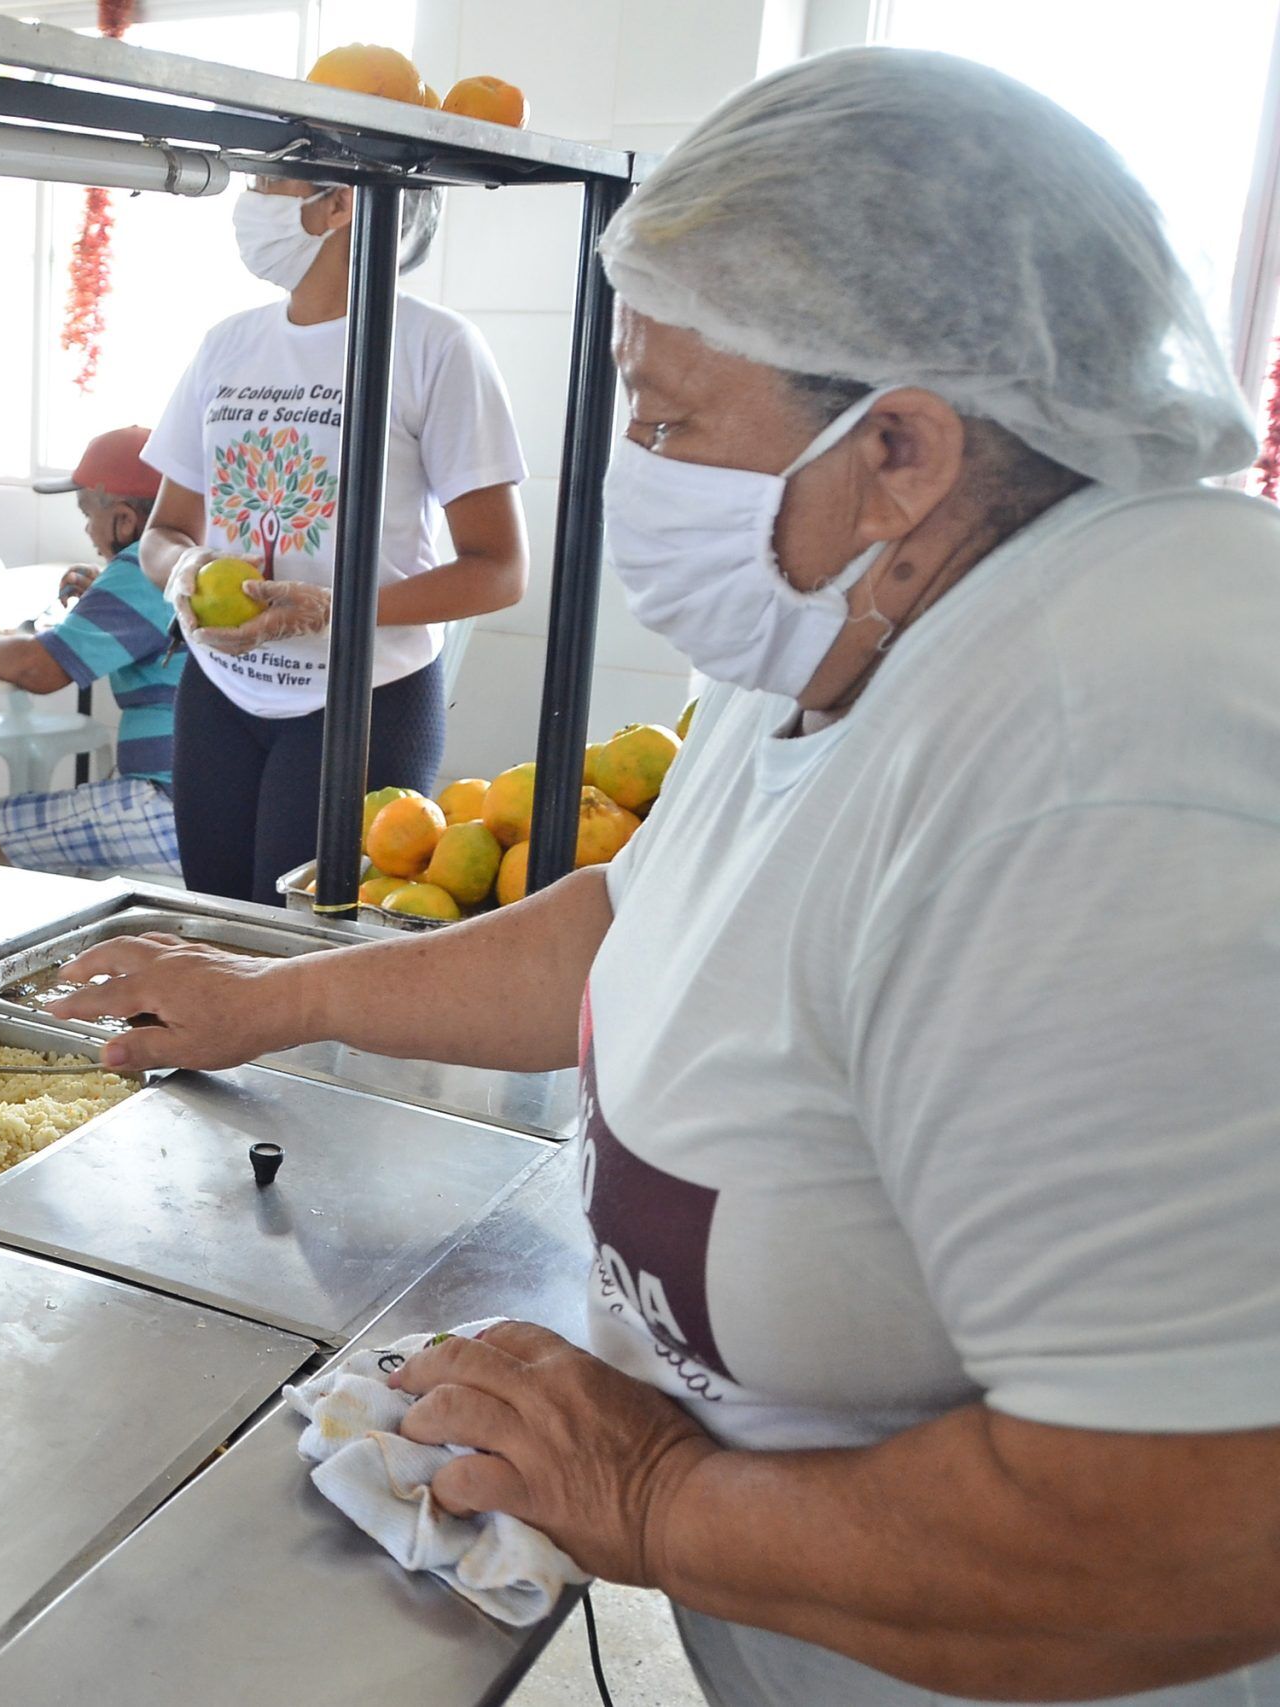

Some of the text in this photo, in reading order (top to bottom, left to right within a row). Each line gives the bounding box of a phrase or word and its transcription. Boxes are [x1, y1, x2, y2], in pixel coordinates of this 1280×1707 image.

[238, 384, 305, 403] Colóquio
[258, 409, 269, 422] e
[261, 652, 301, 670] Física
[247, 667, 274, 683] Bem
[276, 672, 312, 685] Viver
